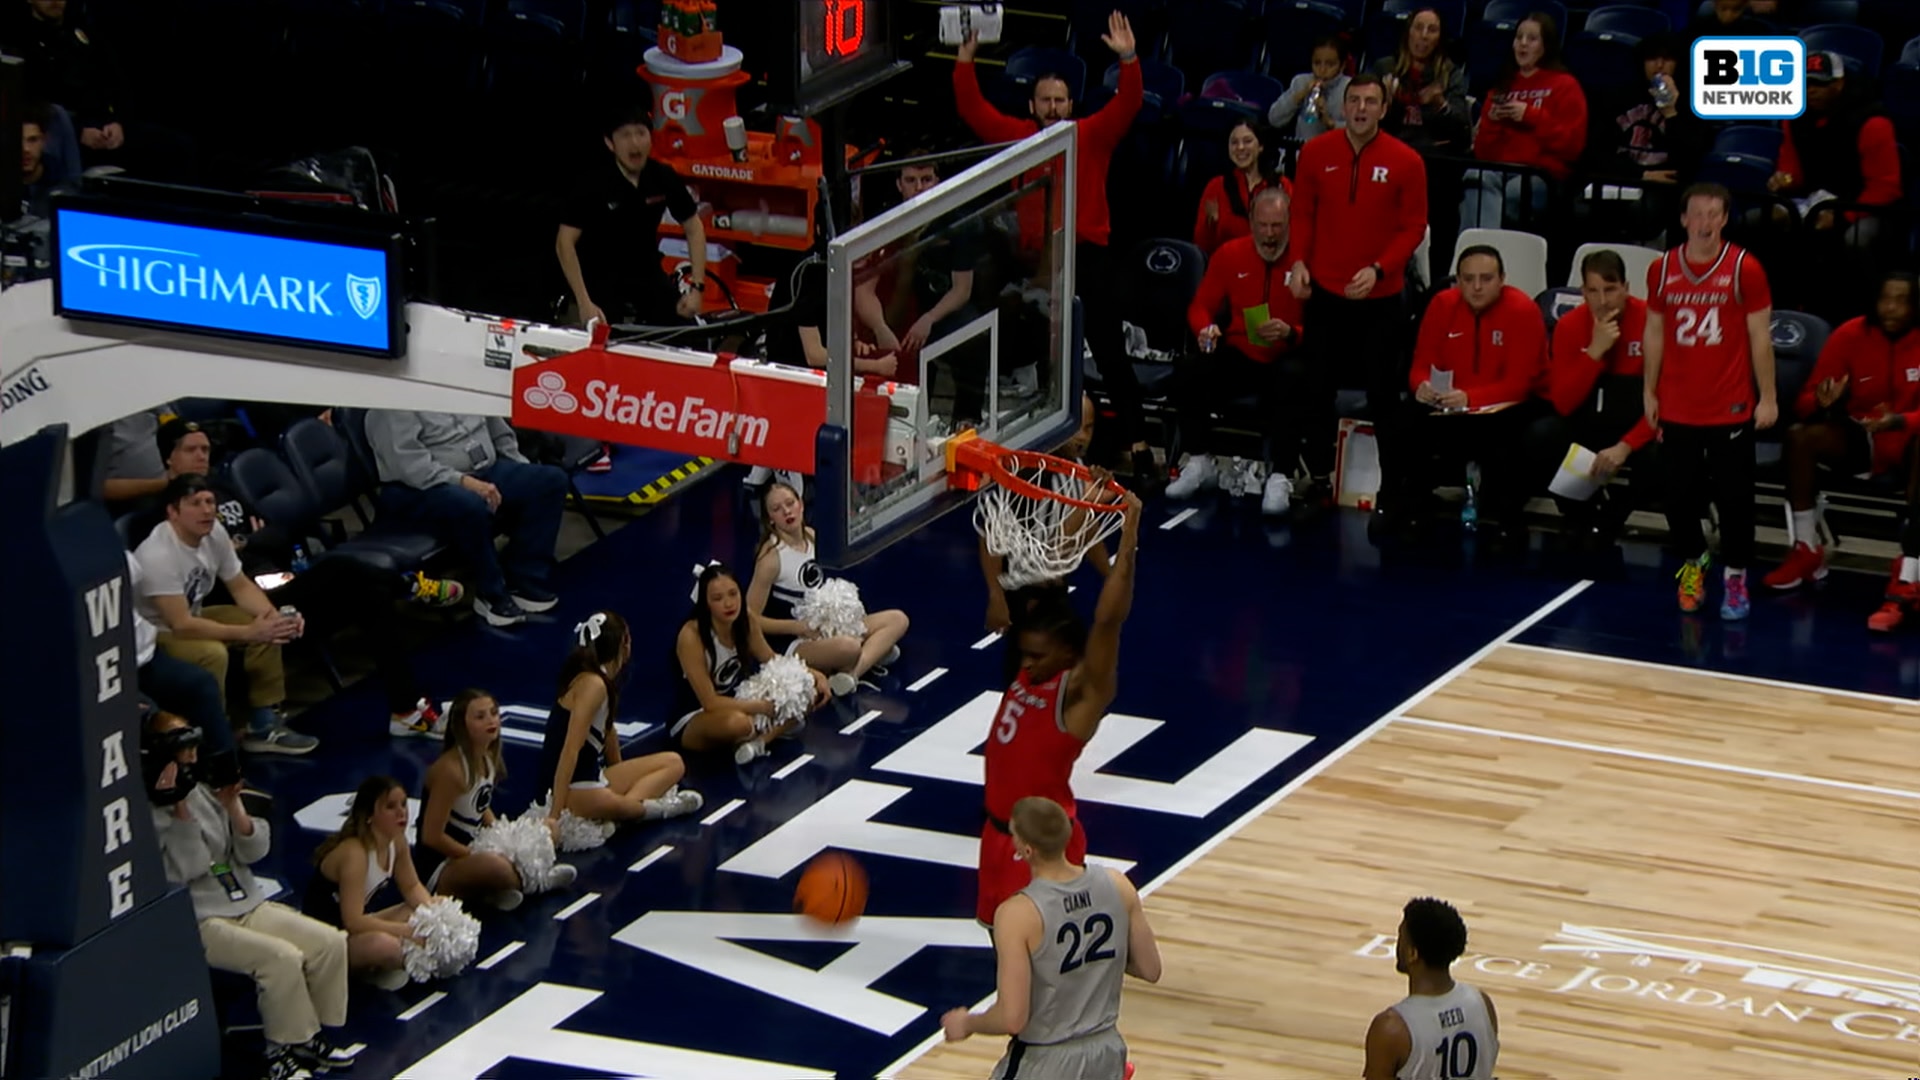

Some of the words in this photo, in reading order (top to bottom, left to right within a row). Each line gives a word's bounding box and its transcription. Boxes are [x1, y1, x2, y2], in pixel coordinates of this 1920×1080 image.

[824, 0, 865, 57] 10
[662, 91, 686, 120] G
[691, 163, 754, 181] GATORADE
[1371, 165, 1389, 183] R
[97, 251, 335, 317] HIGHMARK
[1627, 340, 1643, 357] R
[1675, 305, 1724, 347] 24
[84, 575, 123, 703] WE
[996, 699, 1026, 745] 5
[100, 729, 134, 920] ARE
[1062, 889, 1093, 914] CIANI
[1056, 912, 1116, 975] 22
[1438, 1007, 1465, 1028] REED
[1549, 965, 1815, 1023] JORDAN
[132, 1018, 163, 1054] LION
[164, 998, 200, 1034] CLUB
[1435, 1031, 1478, 1080] 10
